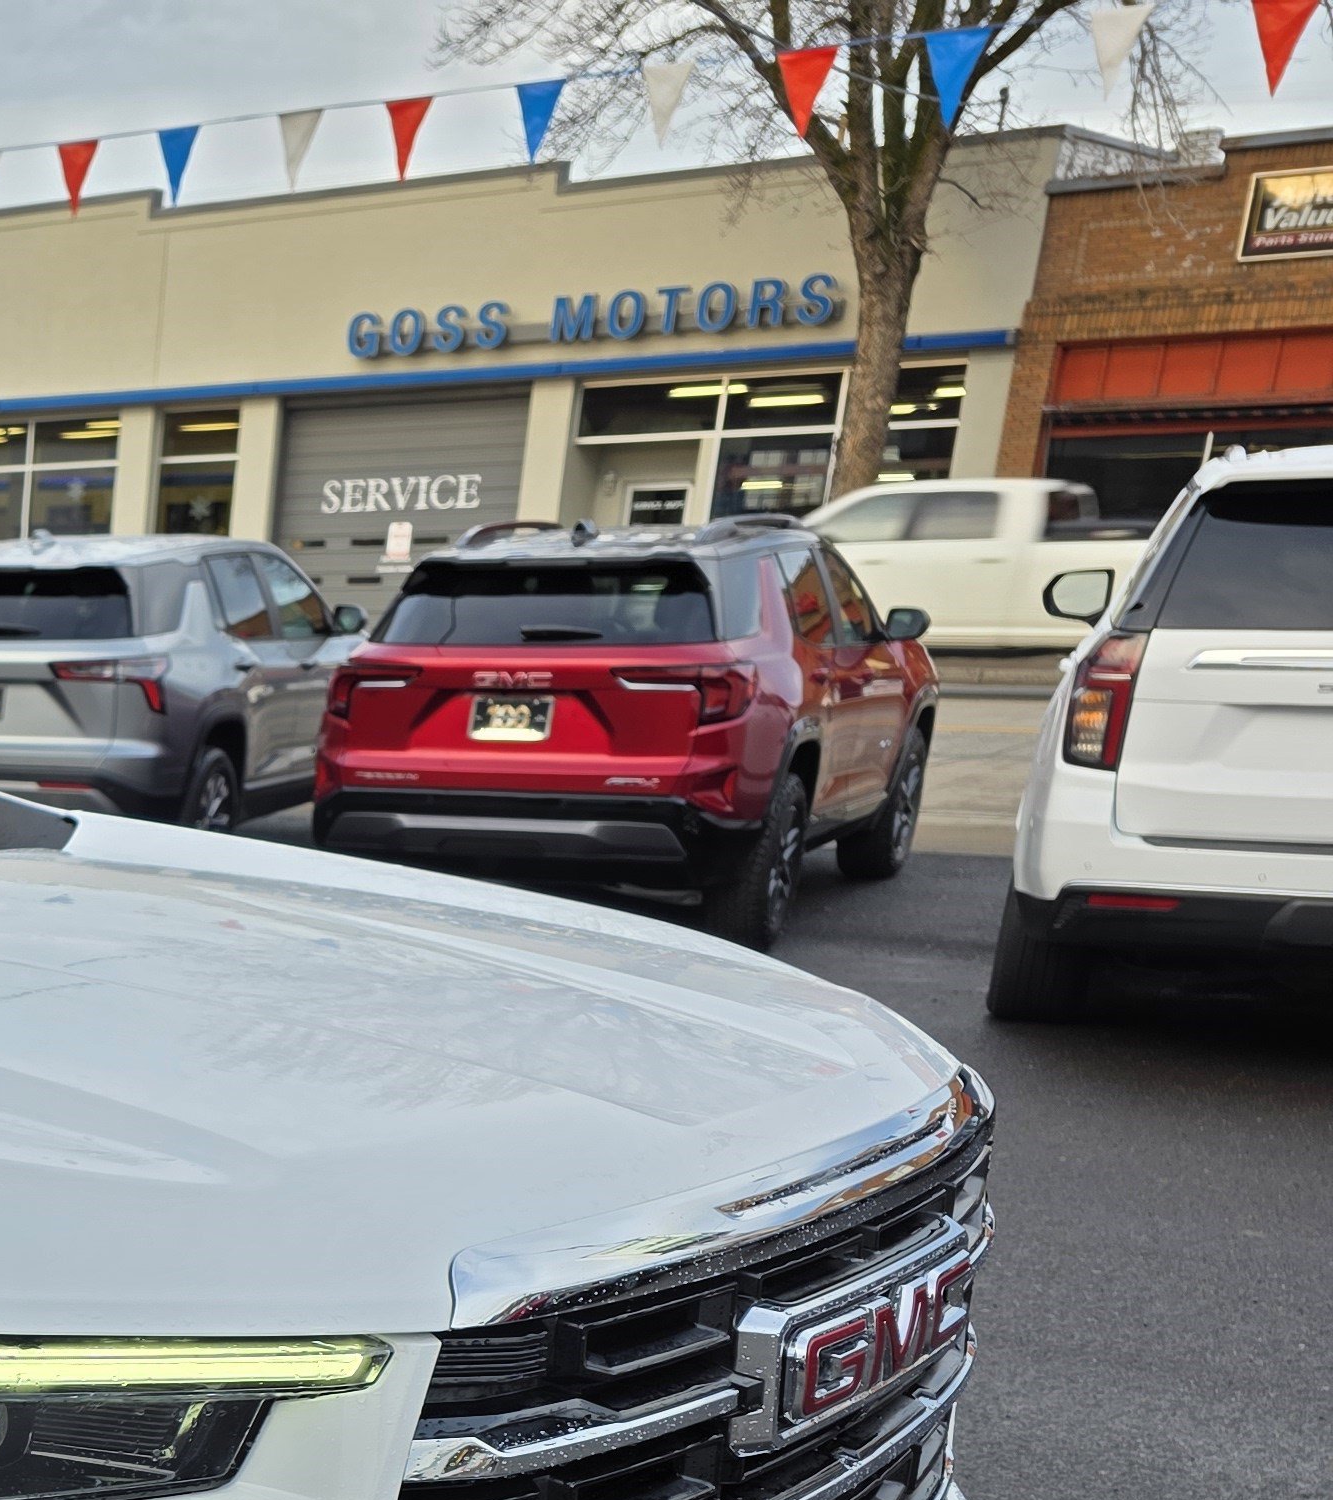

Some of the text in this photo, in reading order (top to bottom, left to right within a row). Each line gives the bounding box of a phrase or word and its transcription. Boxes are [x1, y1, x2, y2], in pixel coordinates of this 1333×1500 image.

[347, 272, 837, 359] GOSS MOTORS
[320, 473, 483, 514] SERVICE
[472, 671, 553, 688] GMC
[800, 1249, 972, 1417] GMC
